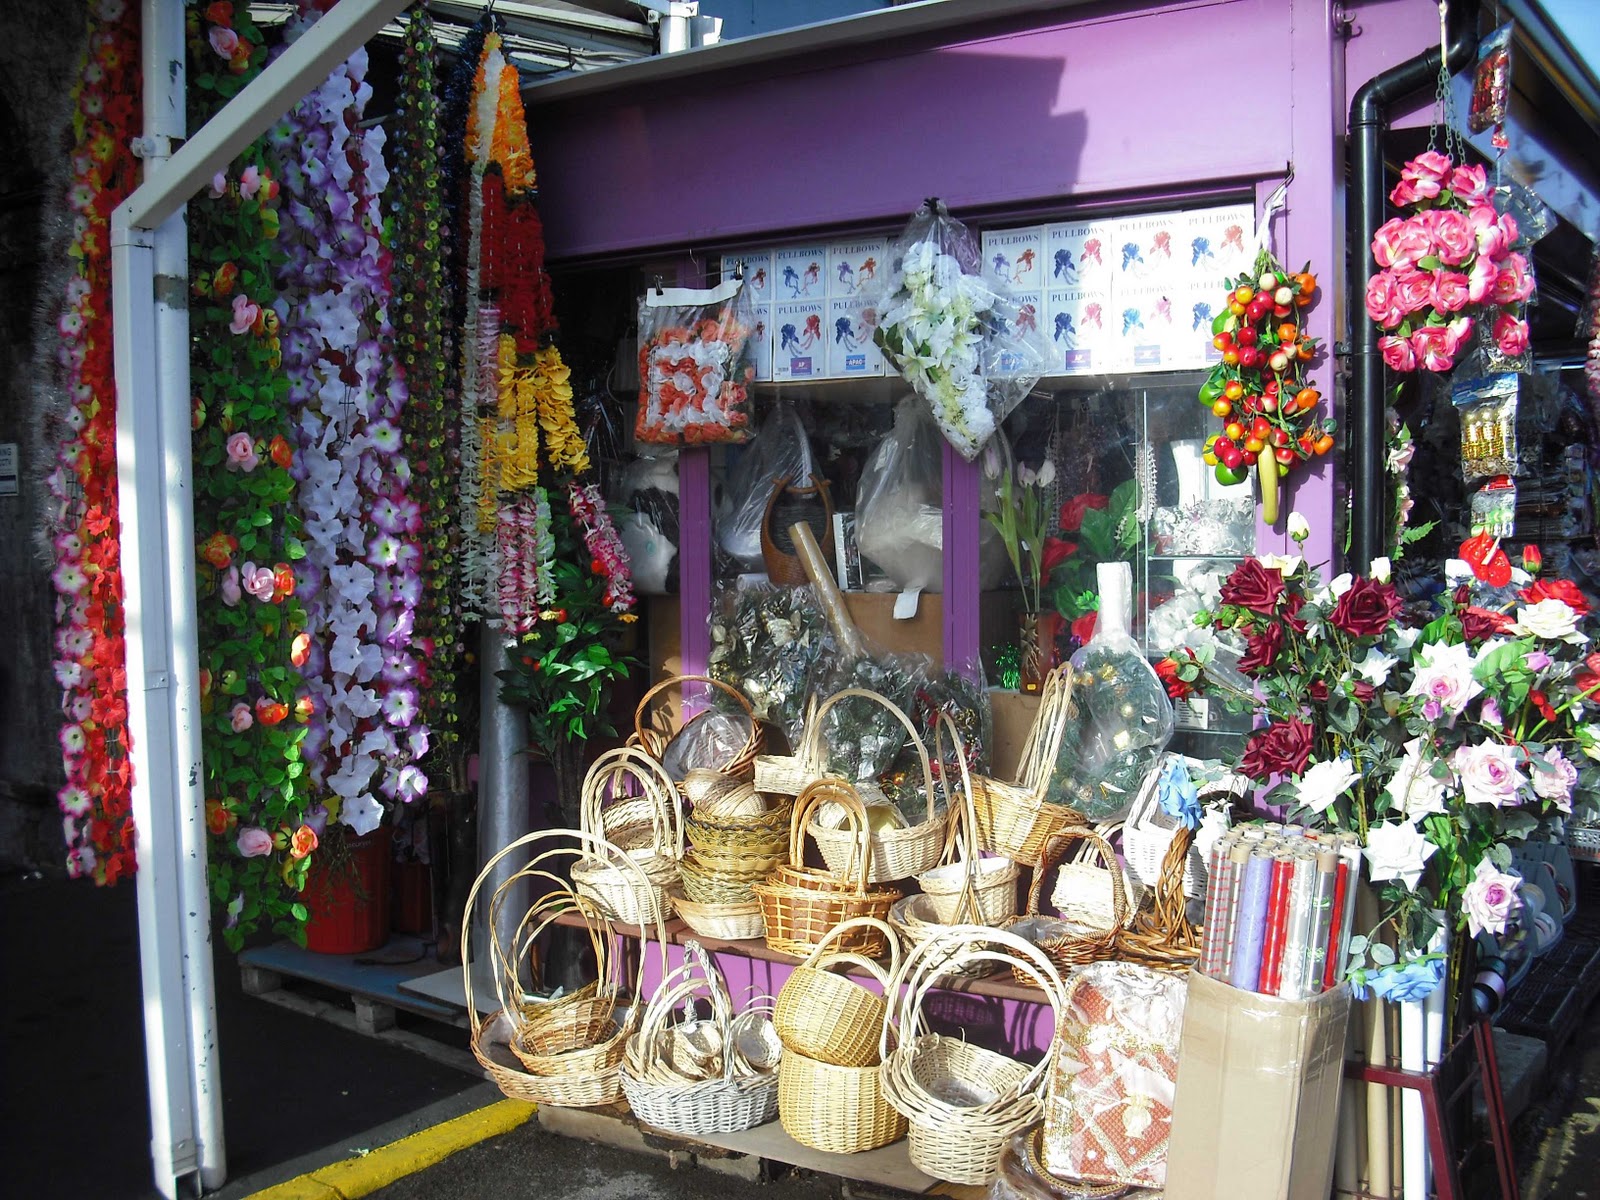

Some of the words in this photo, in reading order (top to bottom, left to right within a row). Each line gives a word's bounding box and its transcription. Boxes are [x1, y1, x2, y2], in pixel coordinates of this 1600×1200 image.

[1052, 228, 1105, 239] PULLBOWS
[988, 234, 1039, 246] PULLBOWS
[778, 250, 823, 259] PULLBOWS
[833, 245, 881, 255] PULLBOWS
[1052, 291, 1105, 302] PULLBOWS
[778, 305, 822, 314] PULLBOWS
